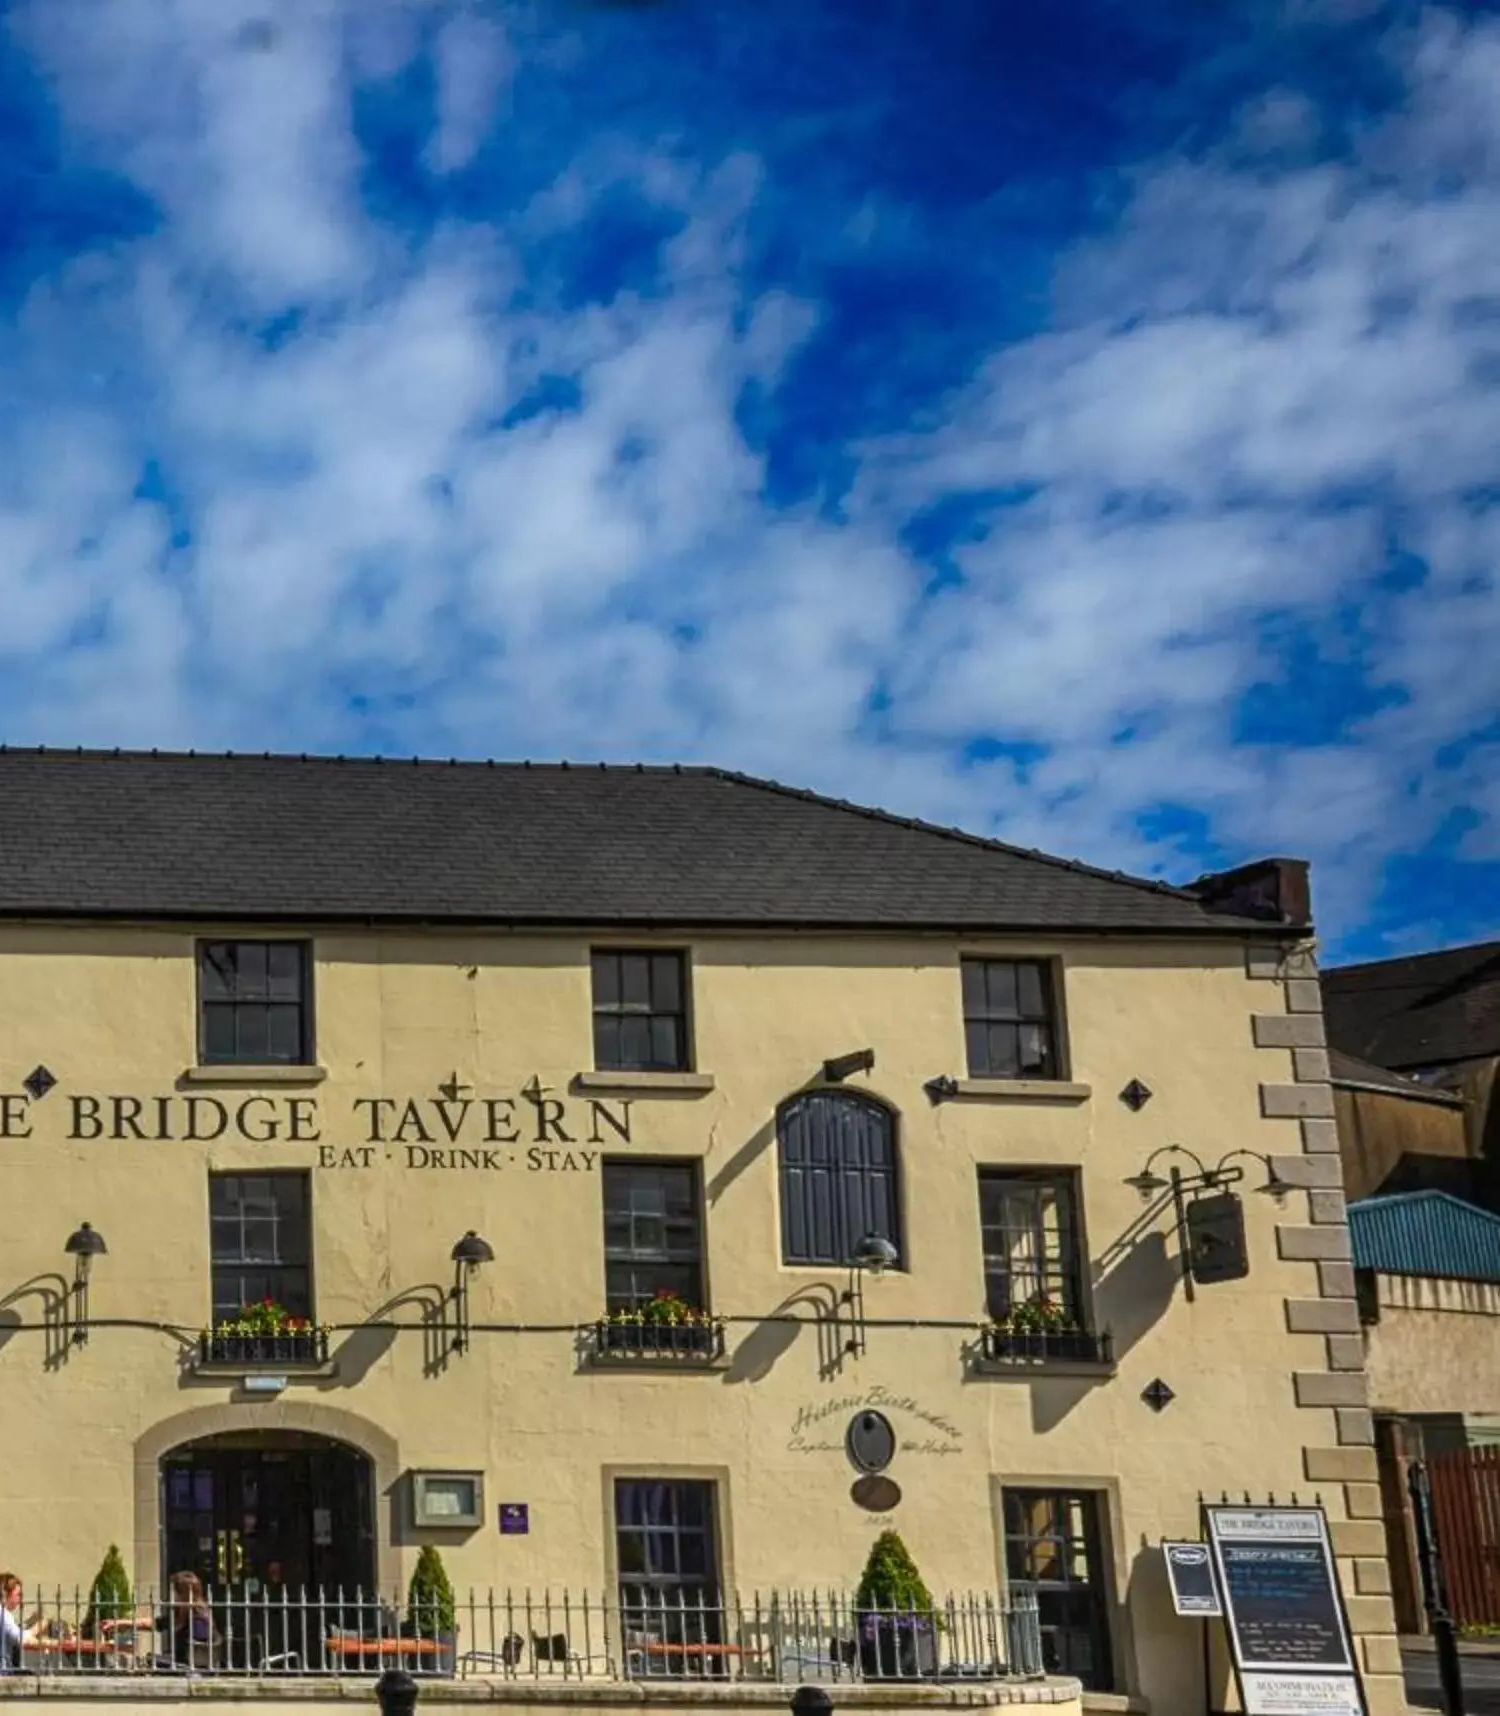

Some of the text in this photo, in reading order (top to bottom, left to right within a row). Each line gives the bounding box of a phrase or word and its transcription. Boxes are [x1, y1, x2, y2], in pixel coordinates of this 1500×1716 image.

[67, 1095, 321, 1141] BRIDGE
[353, 1099, 635, 1143] TAVERN
[317, 1146, 598, 1171] EAT DRINK STAY
